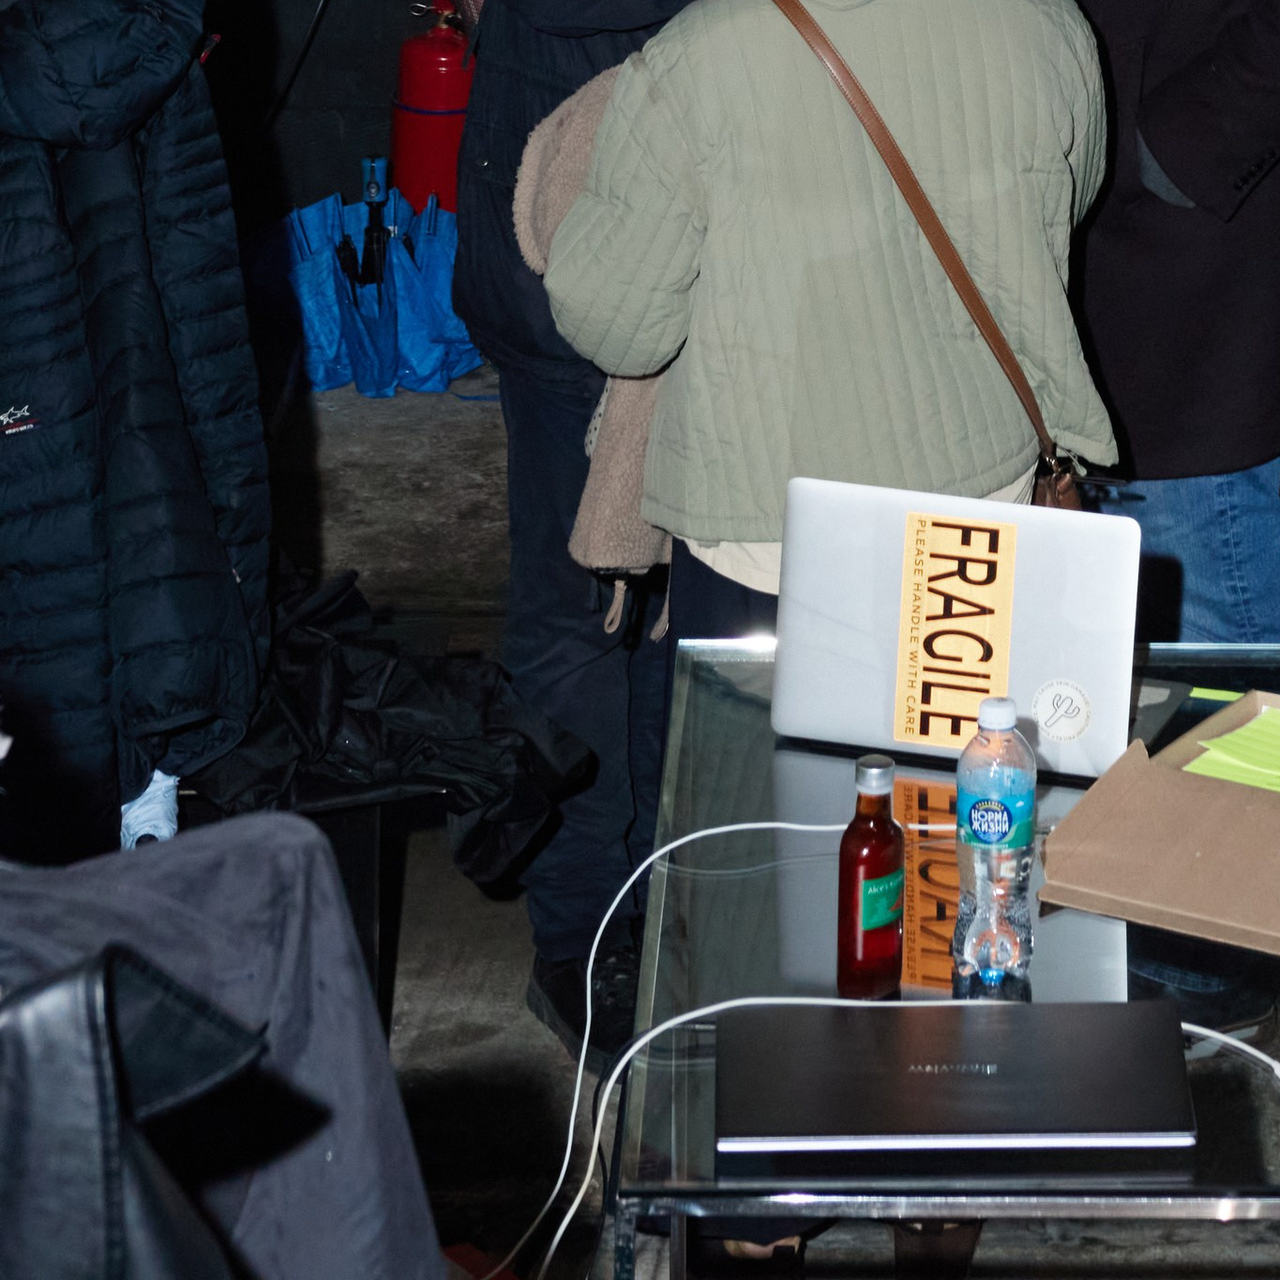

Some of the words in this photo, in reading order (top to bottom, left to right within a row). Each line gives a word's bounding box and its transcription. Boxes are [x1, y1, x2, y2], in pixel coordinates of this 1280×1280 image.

[914, 518, 927, 577] PLEASE
[910, 582, 923, 645] HANDLE
[919, 521, 1000, 737] FRAGILE
[907, 651, 919, 689] WITH
[904, 696, 917, 736] CARE
[971, 809, 1009, 822] НОРМА
[972, 820, 1009, 834] ЖИЗНИ
